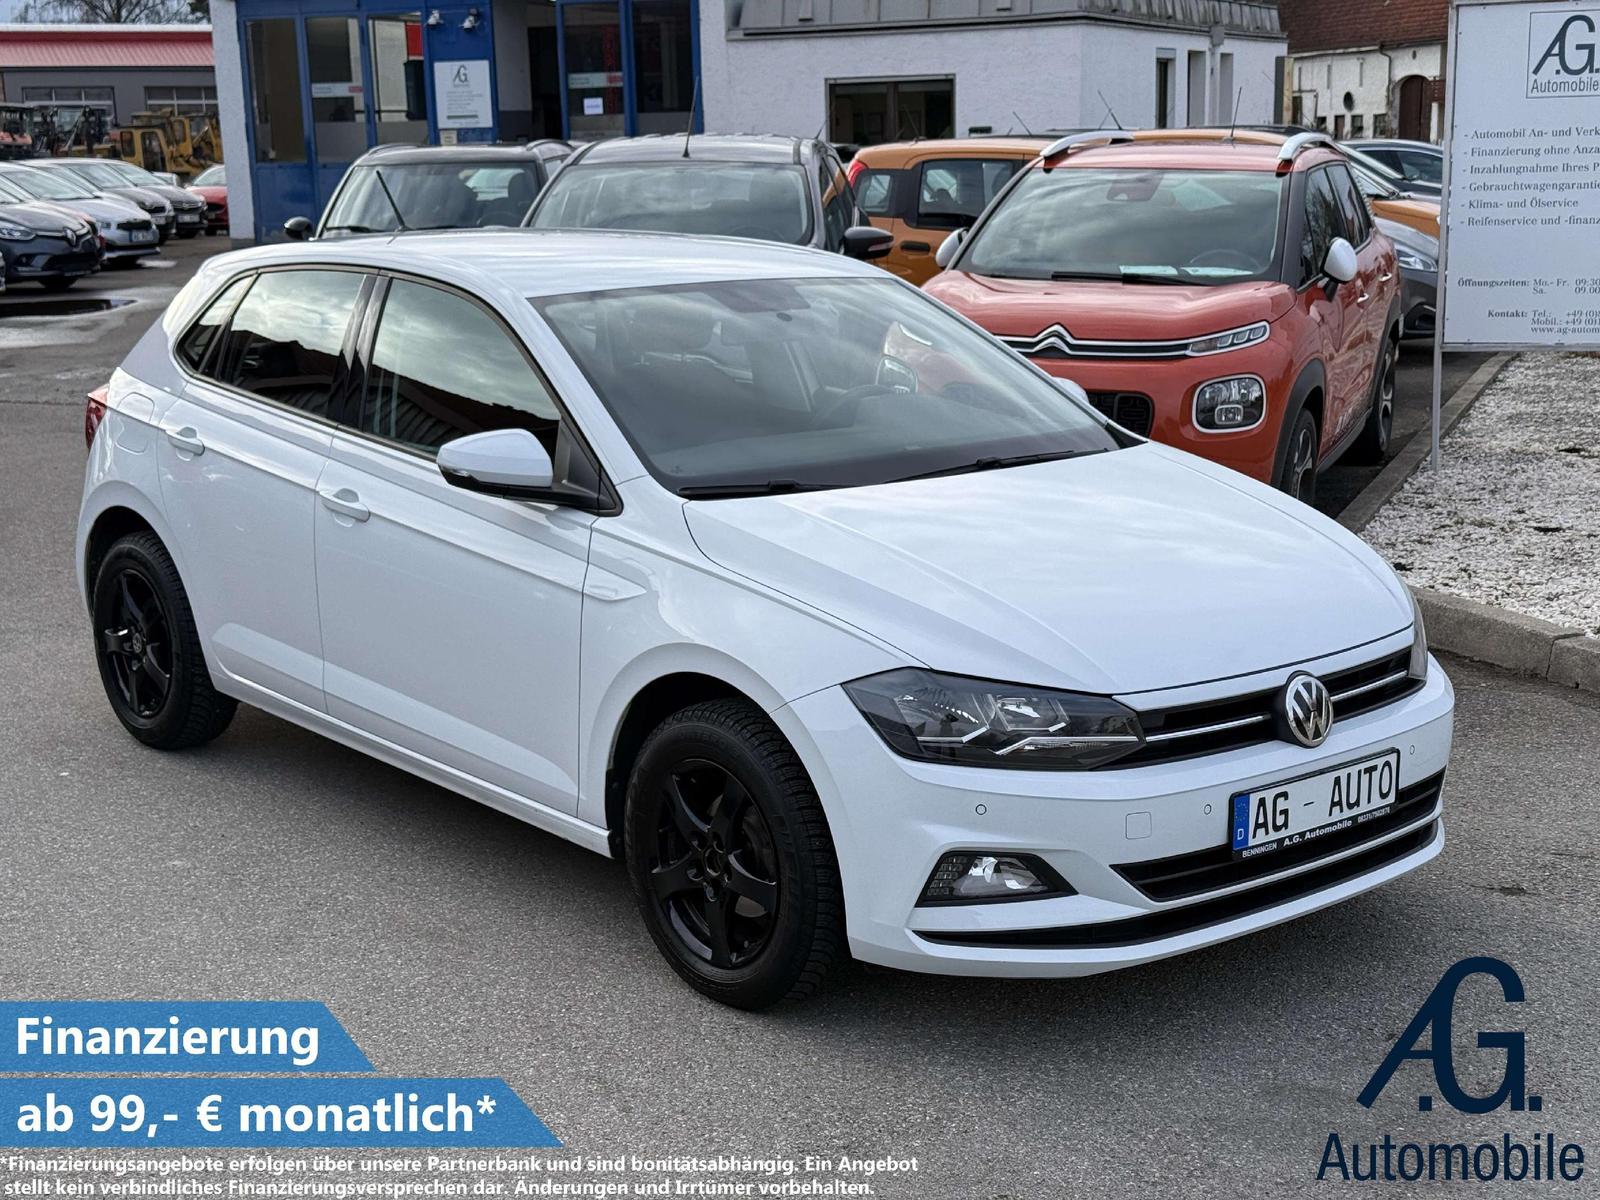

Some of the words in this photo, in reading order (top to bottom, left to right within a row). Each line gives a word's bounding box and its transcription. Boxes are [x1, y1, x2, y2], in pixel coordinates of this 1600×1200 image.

[1530, 77, 1599, 94] Automobile
[1471, 128, 1526, 140] Automobil
[1528, 128, 1548, 138] An-
[1551, 127, 1572, 137] und
[1471, 146, 1541, 158] Finanzierung
[1544, 145, 1570, 155] ohne
[1470, 163, 1559, 175] Inzahlungnahme
[1561, 162, 1590, 173] Ihres
[1468, 199, 1503, 209] Klima-
[1506, 198, 1526, 208] und
[1529, 197, 1579, 208] Ölservice
[1467, 216, 1537, 227] Reifenservice
[1540, 215, 1560, 225] und
[1457, 277, 1530, 288] Öffnungszeiten:
[1556, 278, 1570, 287] Fr.
[1532, 287, 1547, 295] Sa.
[1487, 309, 1528, 318] Kontakt:
[1566, 310, 1583, 318] +49
[1237, 828, 1245, 841] D
[1252, 790, 1289, 839] AG
[1328, 760, 1393, 817] AUTO
[1242, 842, 1277, 858] BENNINGEN
[1283, 835, 1303, 847] A.G.
[1304, 819, 1352, 840] Automobile
